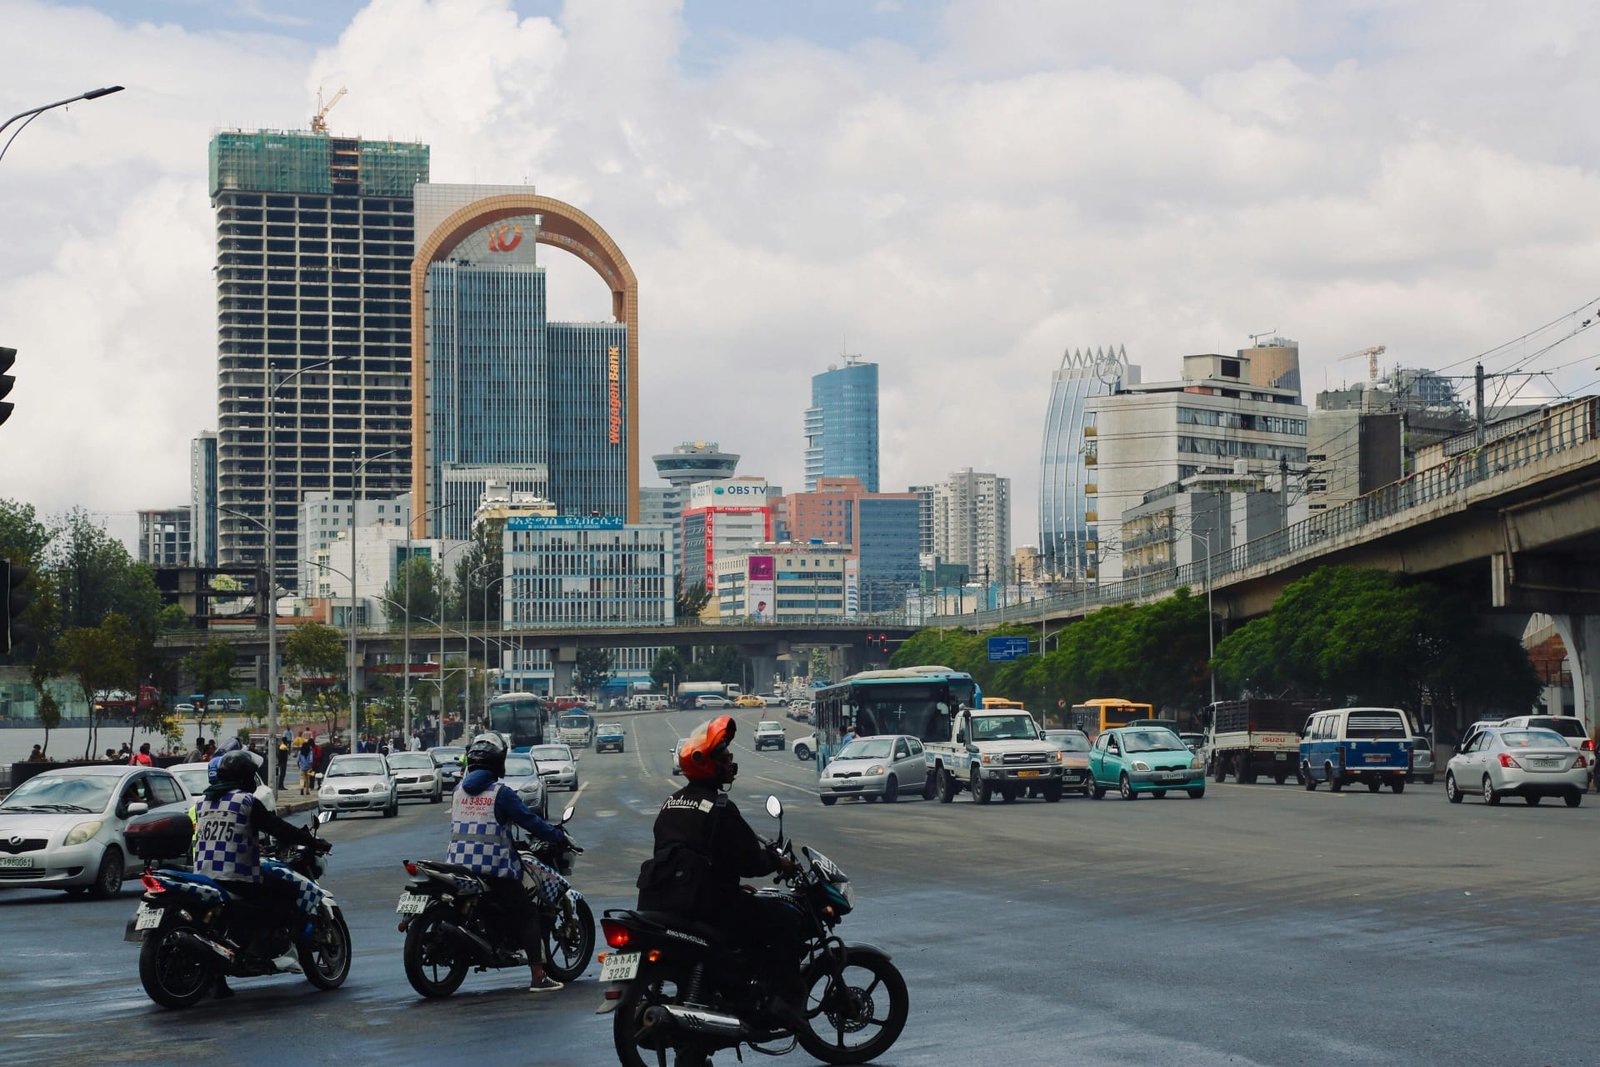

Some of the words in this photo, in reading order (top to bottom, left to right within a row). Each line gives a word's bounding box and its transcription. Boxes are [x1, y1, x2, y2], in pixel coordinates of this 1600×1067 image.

[609, 346, 619, 381] Bank
[609, 382, 621, 443] Wegagen
[727, 485, 750, 495] OBS
[752, 485, 767, 495] TV
[607, 966, 631, 980] 3228
